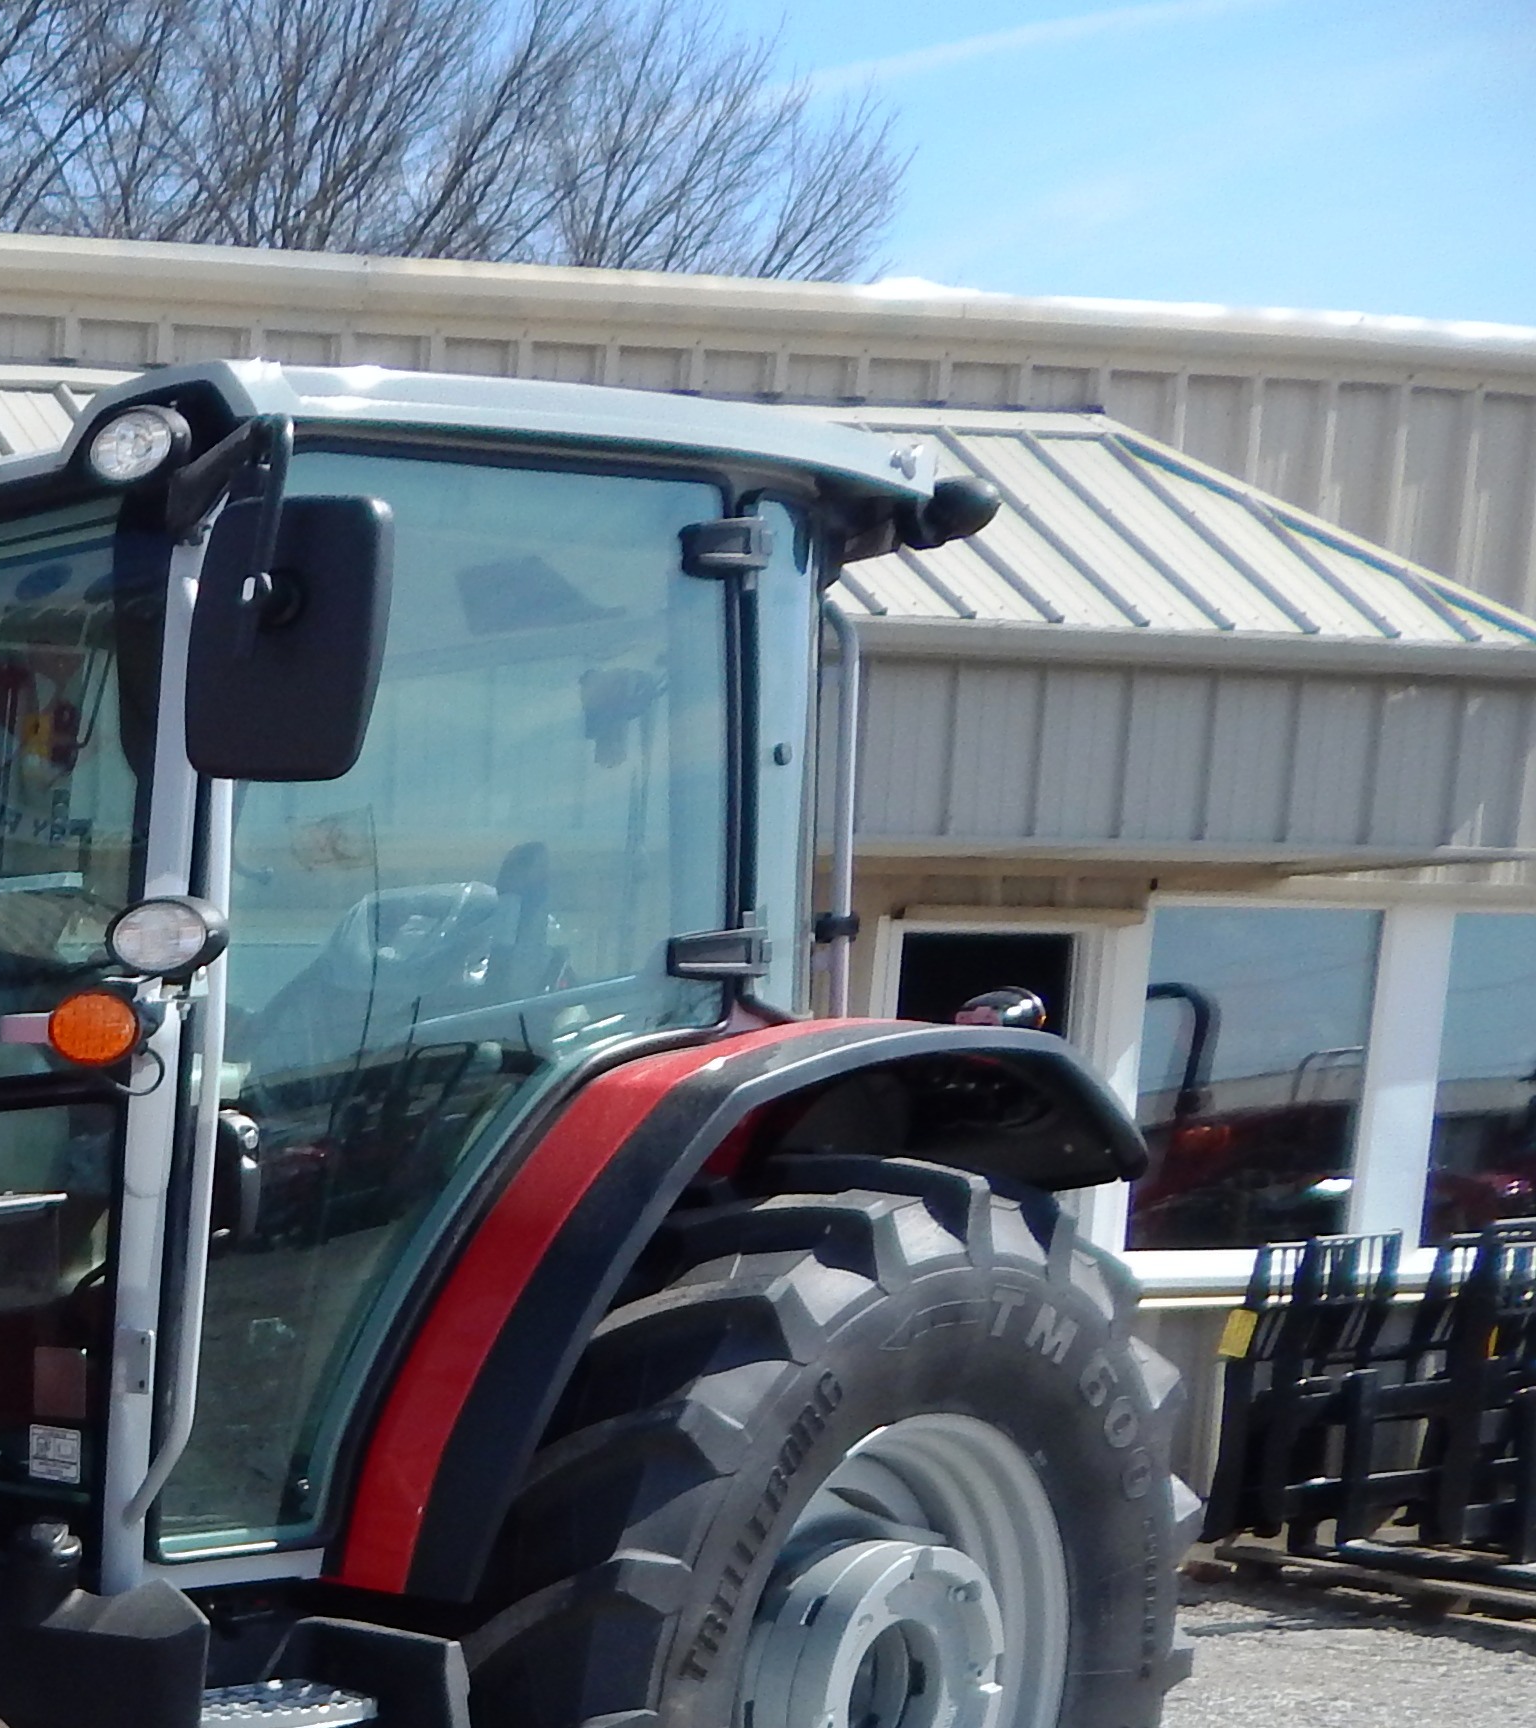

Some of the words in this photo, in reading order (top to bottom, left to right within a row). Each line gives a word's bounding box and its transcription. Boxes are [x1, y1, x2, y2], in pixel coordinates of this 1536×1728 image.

[990, 1283, 1078, 1364] TM
[1079, 1347, 1154, 1500] 600
[679, 1369, 844, 1682] TRELLEBORG
